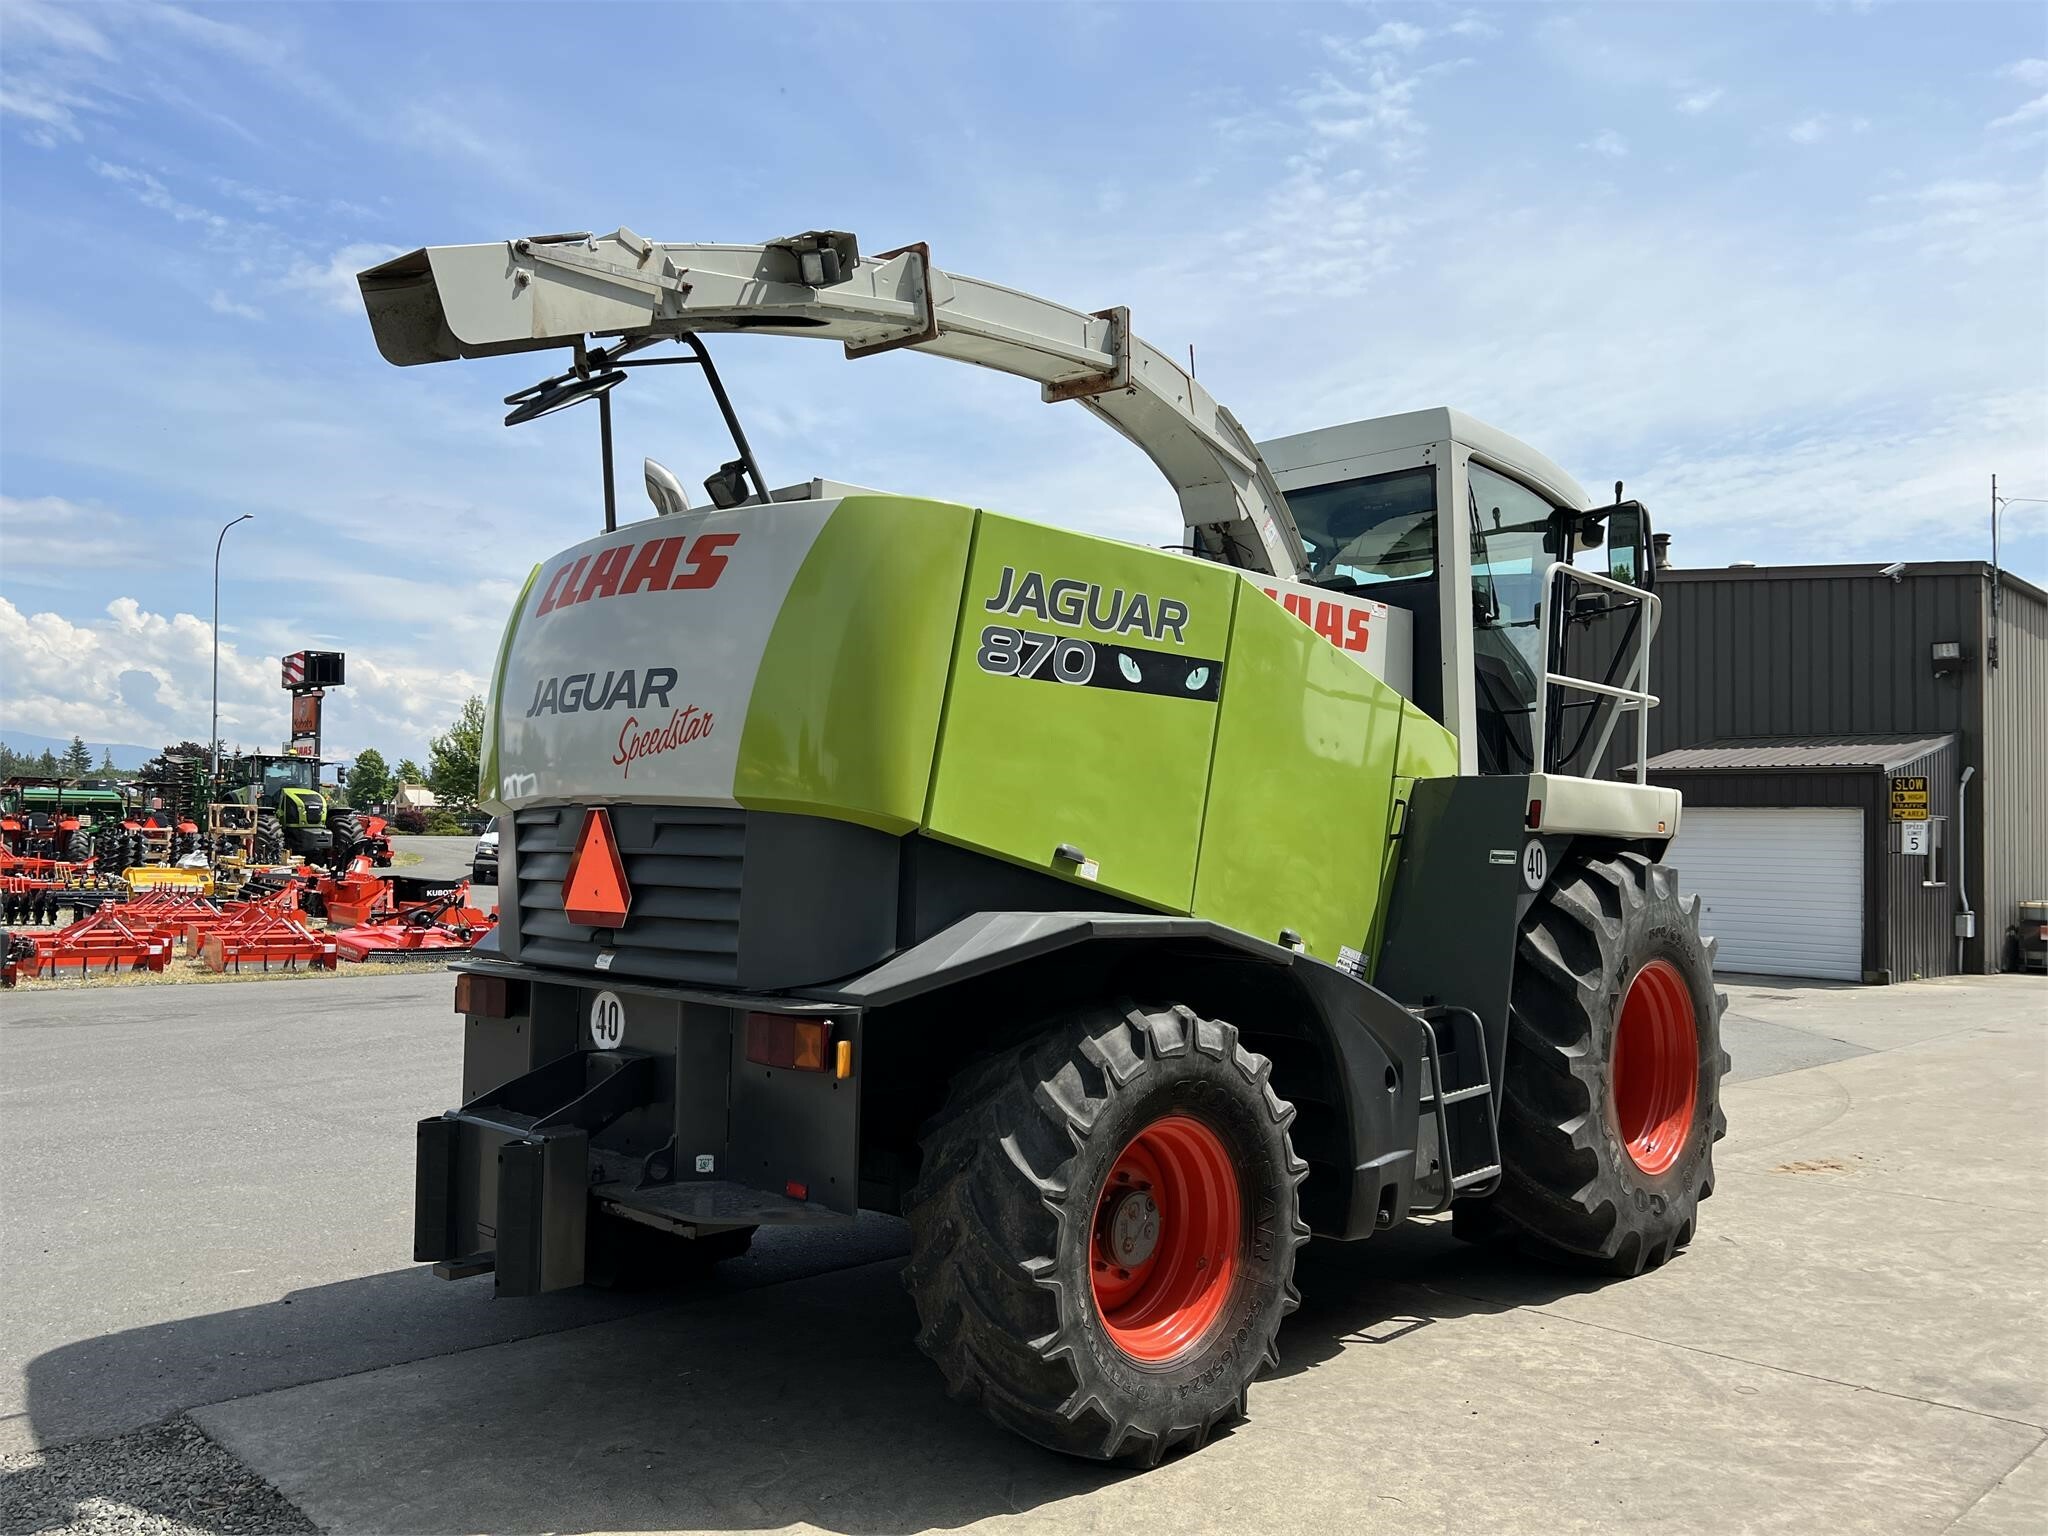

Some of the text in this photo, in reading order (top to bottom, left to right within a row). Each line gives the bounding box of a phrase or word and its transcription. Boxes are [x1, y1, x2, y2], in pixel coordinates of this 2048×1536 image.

[535, 533, 741, 618] CLAAS
[985, 566, 1190, 646] JAGUAR
[1263, 587, 1371, 653] AAS
[976, 624, 1097, 686] 870
[526, 667, 678, 718] JAGUAR
[612, 704, 714, 779] Speedstar
[1895, 778, 1924, 791] SLOW
[1527, 848, 1543, 880] 40
[1910, 837, 1919, 851] 5
[595, 1000, 619, 1042] 40
